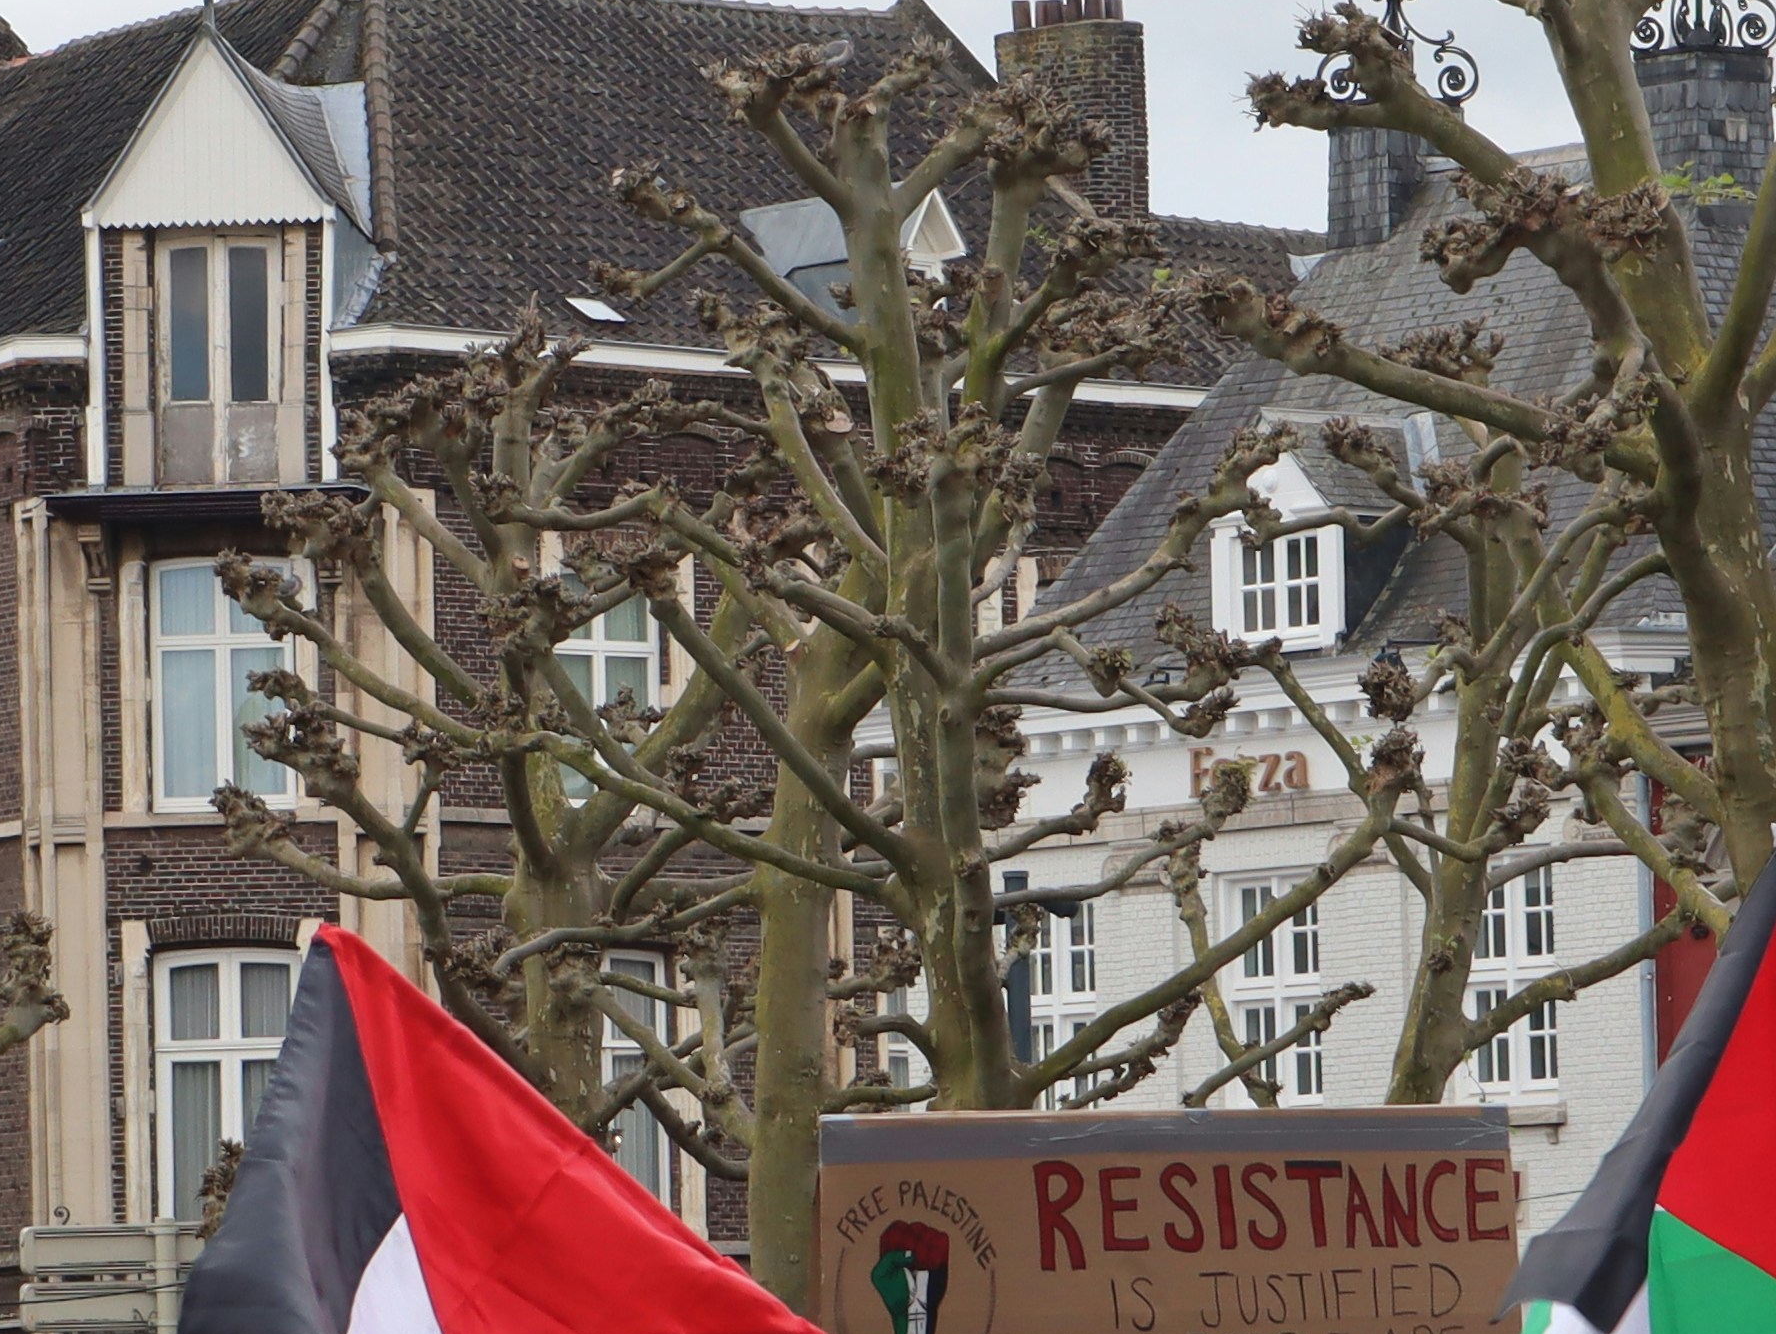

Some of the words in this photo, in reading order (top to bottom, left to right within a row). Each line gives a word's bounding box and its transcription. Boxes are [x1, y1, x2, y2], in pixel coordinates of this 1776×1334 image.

[1188, 747, 1311, 798] Foza
[836, 1185, 889, 1244] FREE
[898, 1180, 997, 1270] PALESTINE
[1032, 1158, 1511, 1271] RESISTANCE
[1111, 1277, 1156, 1331] IS
[1199, 1263, 1463, 1329] JUSTIFIED
